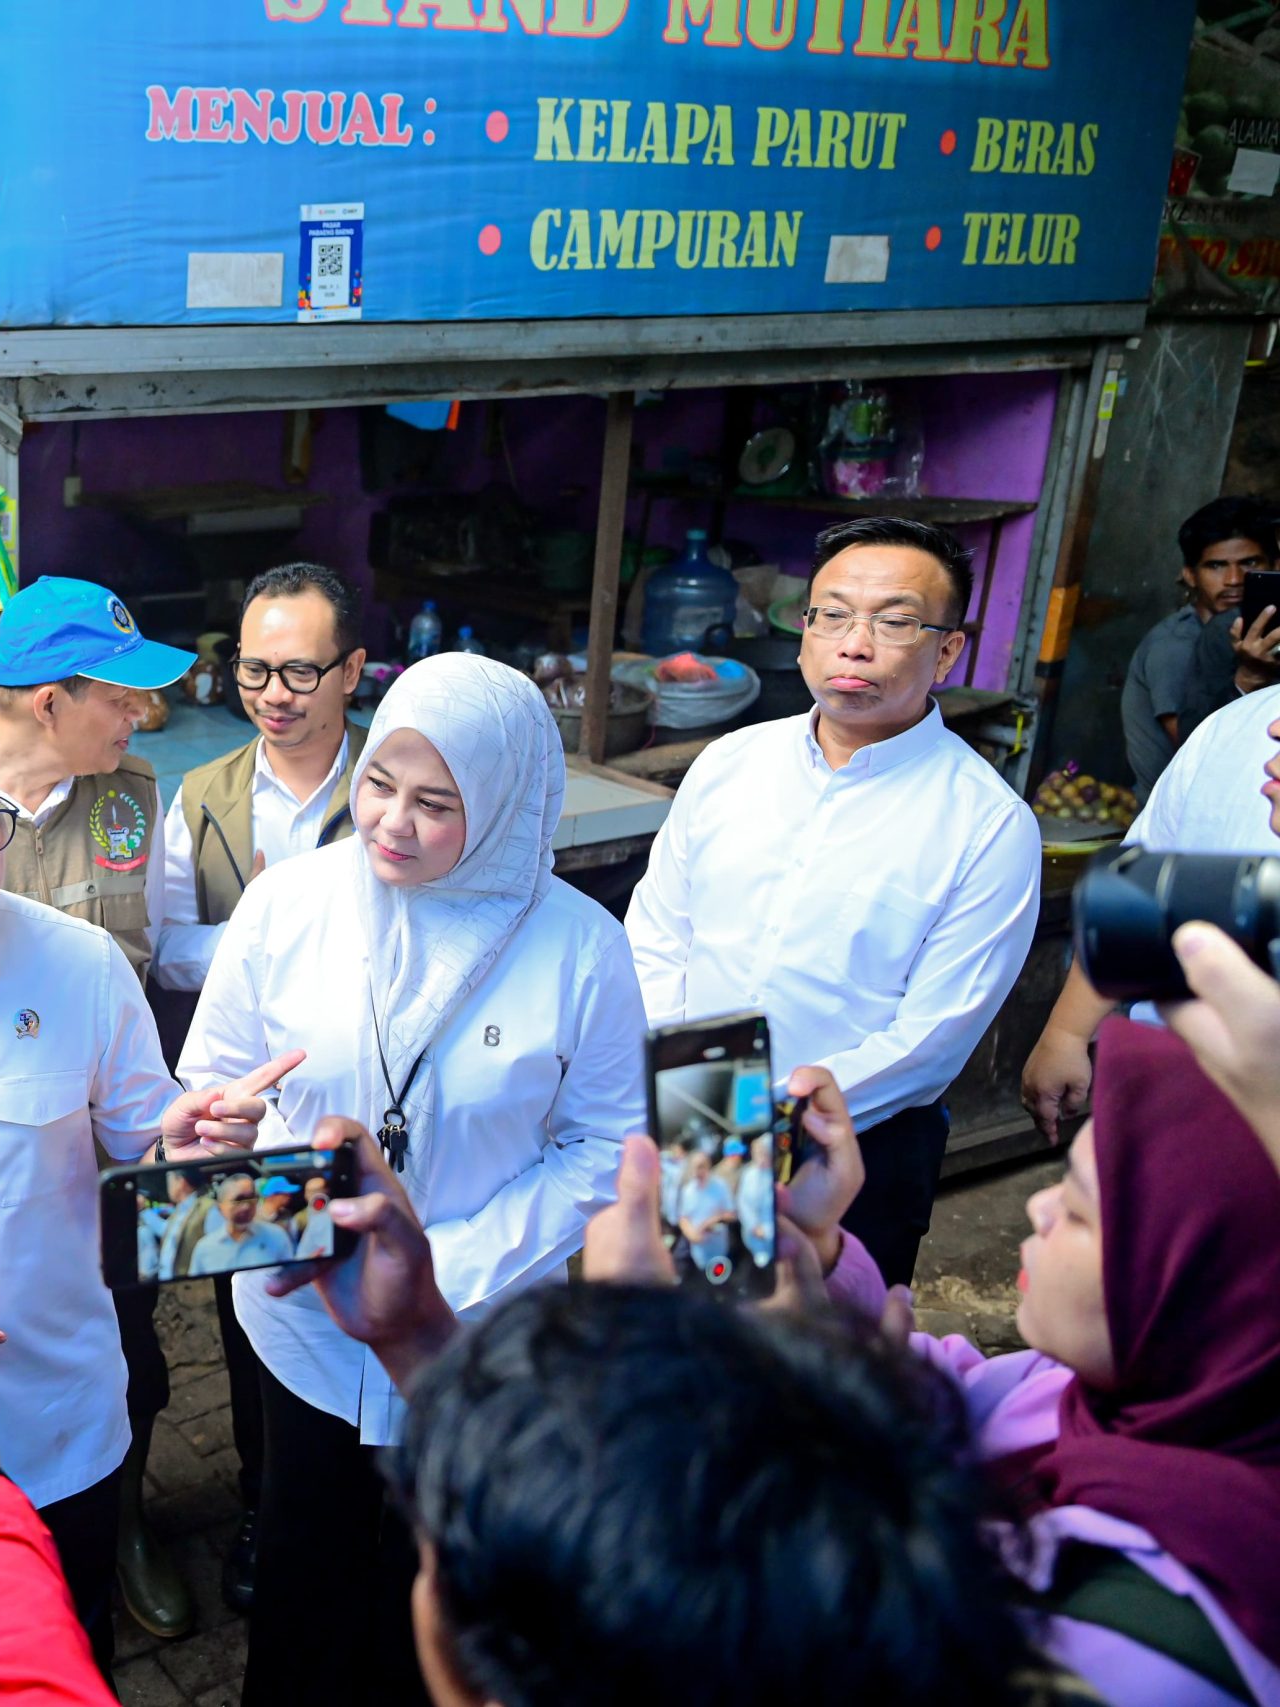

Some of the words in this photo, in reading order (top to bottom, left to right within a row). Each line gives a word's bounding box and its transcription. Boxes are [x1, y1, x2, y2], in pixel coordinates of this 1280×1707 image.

[534, 98, 734, 165] KELAPA
[751, 107, 907, 170] PARUT
[970, 117, 1099, 175] BERAS
[530, 208, 803, 271] CAMPURAN
[961, 211, 1081, 266] TELUR
